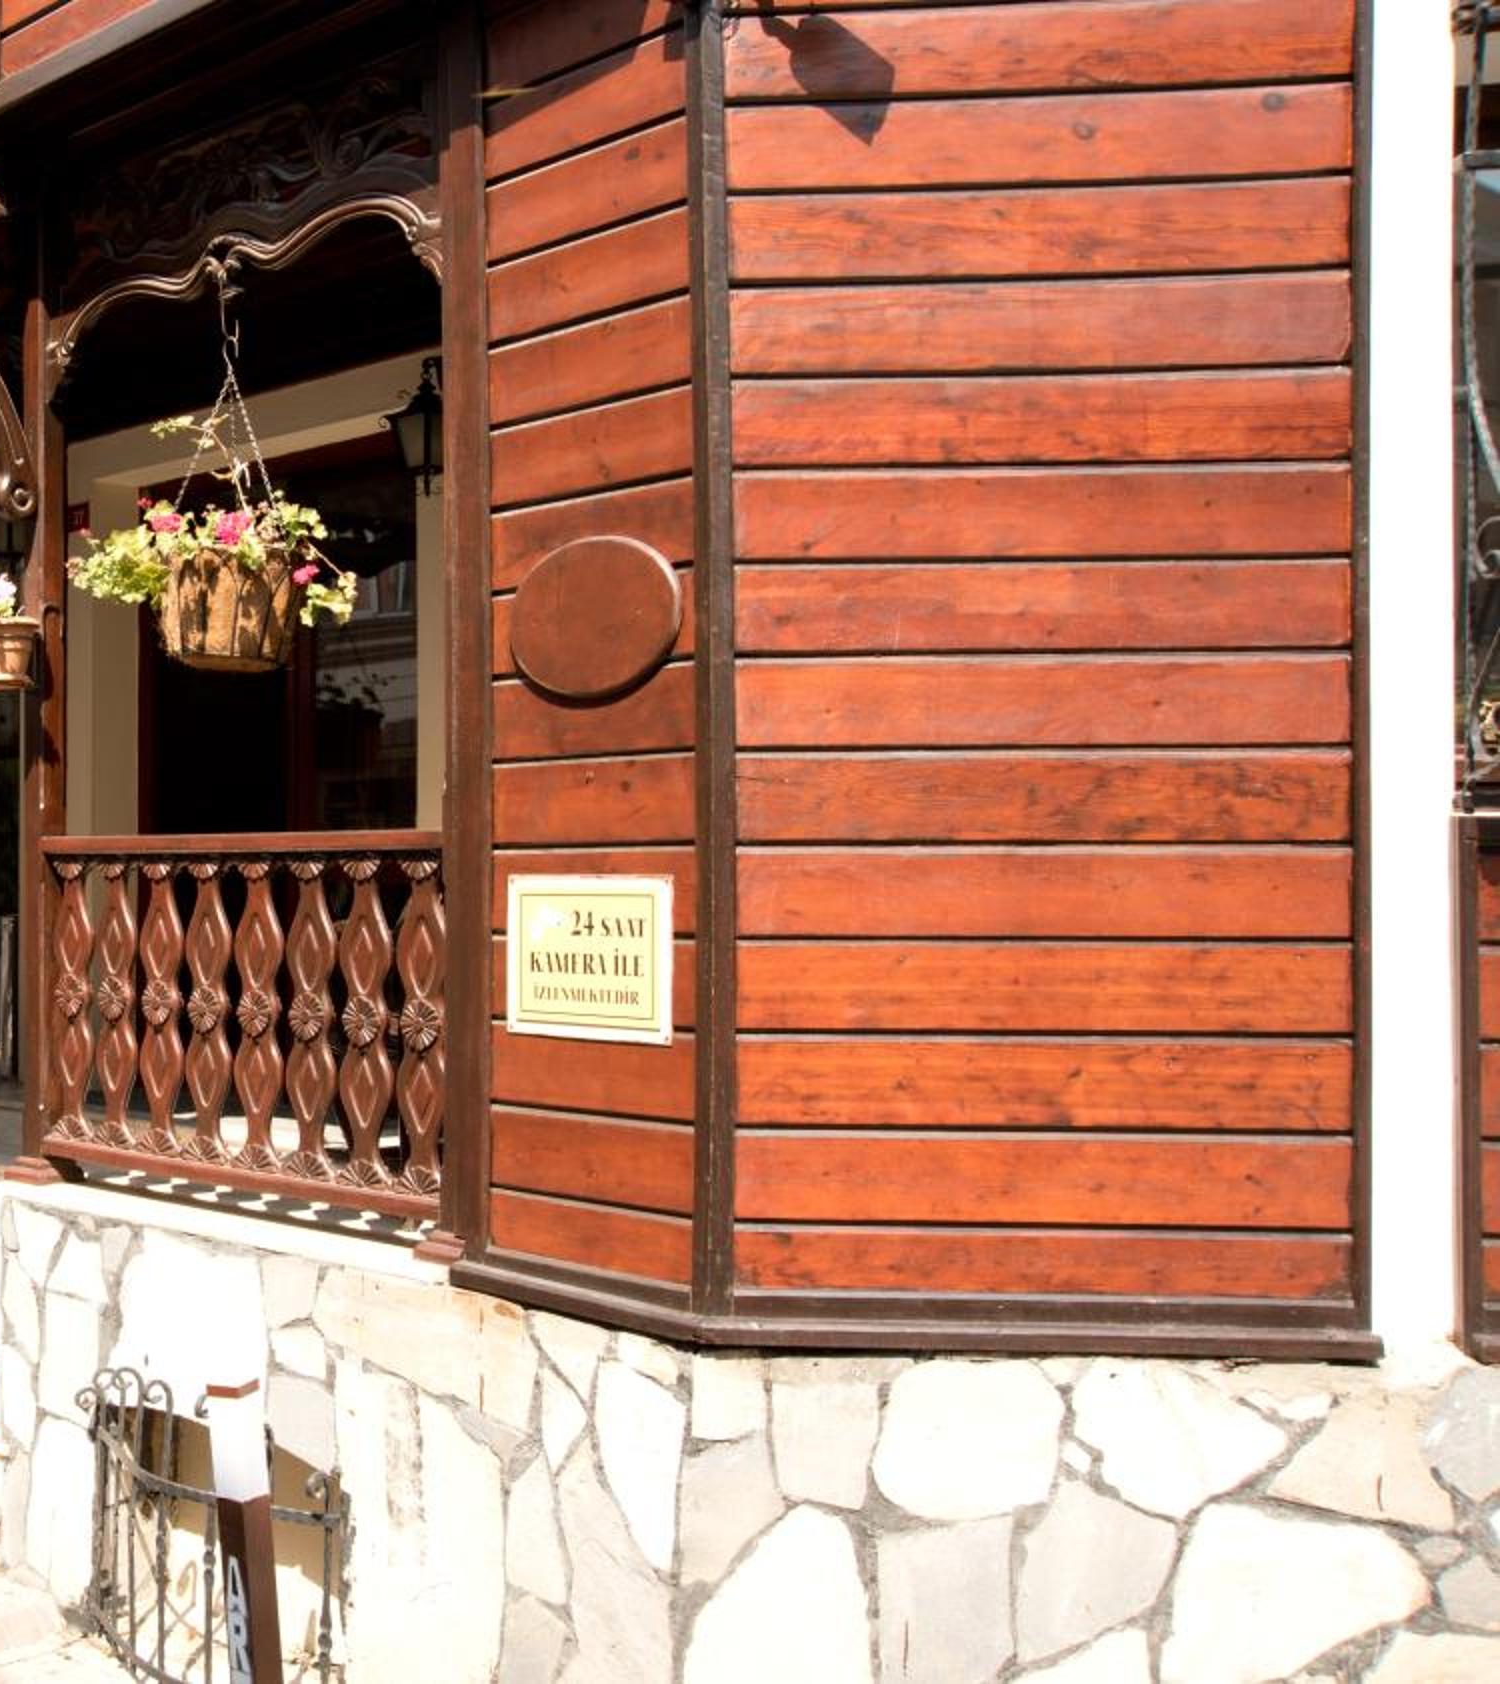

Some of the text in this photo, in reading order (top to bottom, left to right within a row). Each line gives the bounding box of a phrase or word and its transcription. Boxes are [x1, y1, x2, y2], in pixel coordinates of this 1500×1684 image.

[571, 911, 645, 938] 24 SAAT
[530, 948, 645, 977] KAMERA İLE
